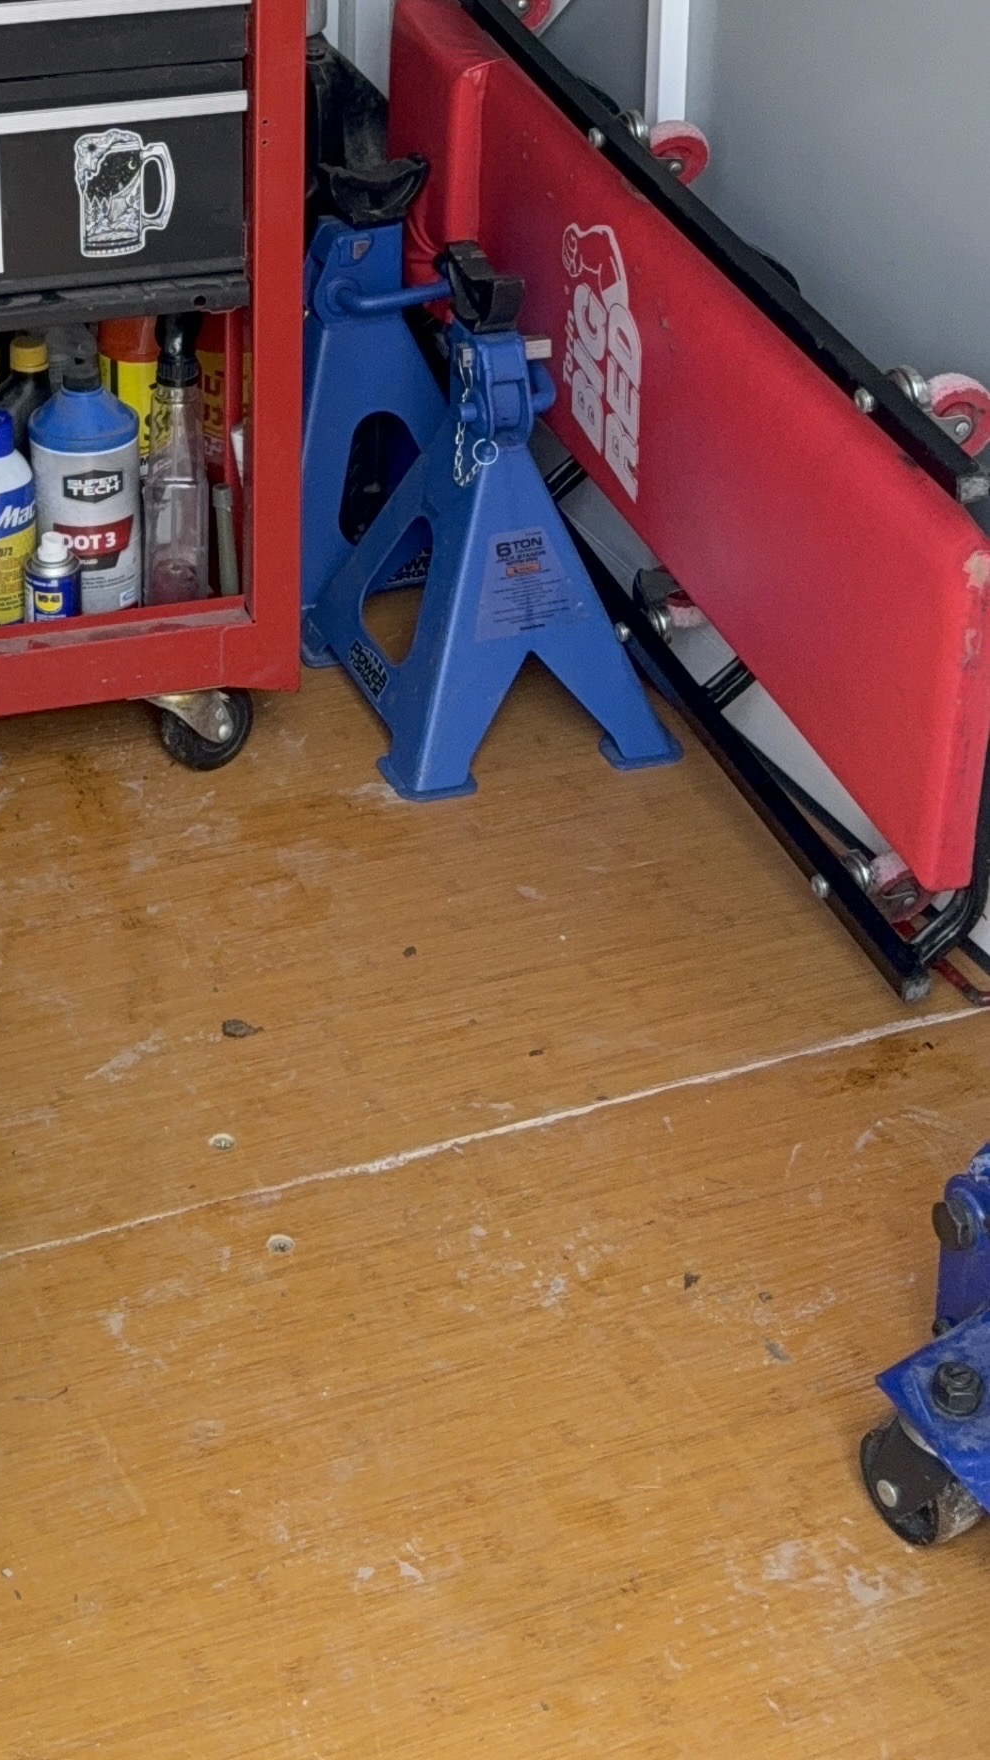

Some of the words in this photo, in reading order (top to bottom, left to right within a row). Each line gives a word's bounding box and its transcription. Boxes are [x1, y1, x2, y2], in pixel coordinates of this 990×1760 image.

[572, 282, 608, 455] BIG
[605, 302, 642, 504] RED
[67, 474, 121, 490] SUPER
[71, 480, 120, 497] TECH
[61, 533, 103, 550] DOT
[105, 531, 117, 549] 3
[351, 642, 387, 688] POWER
